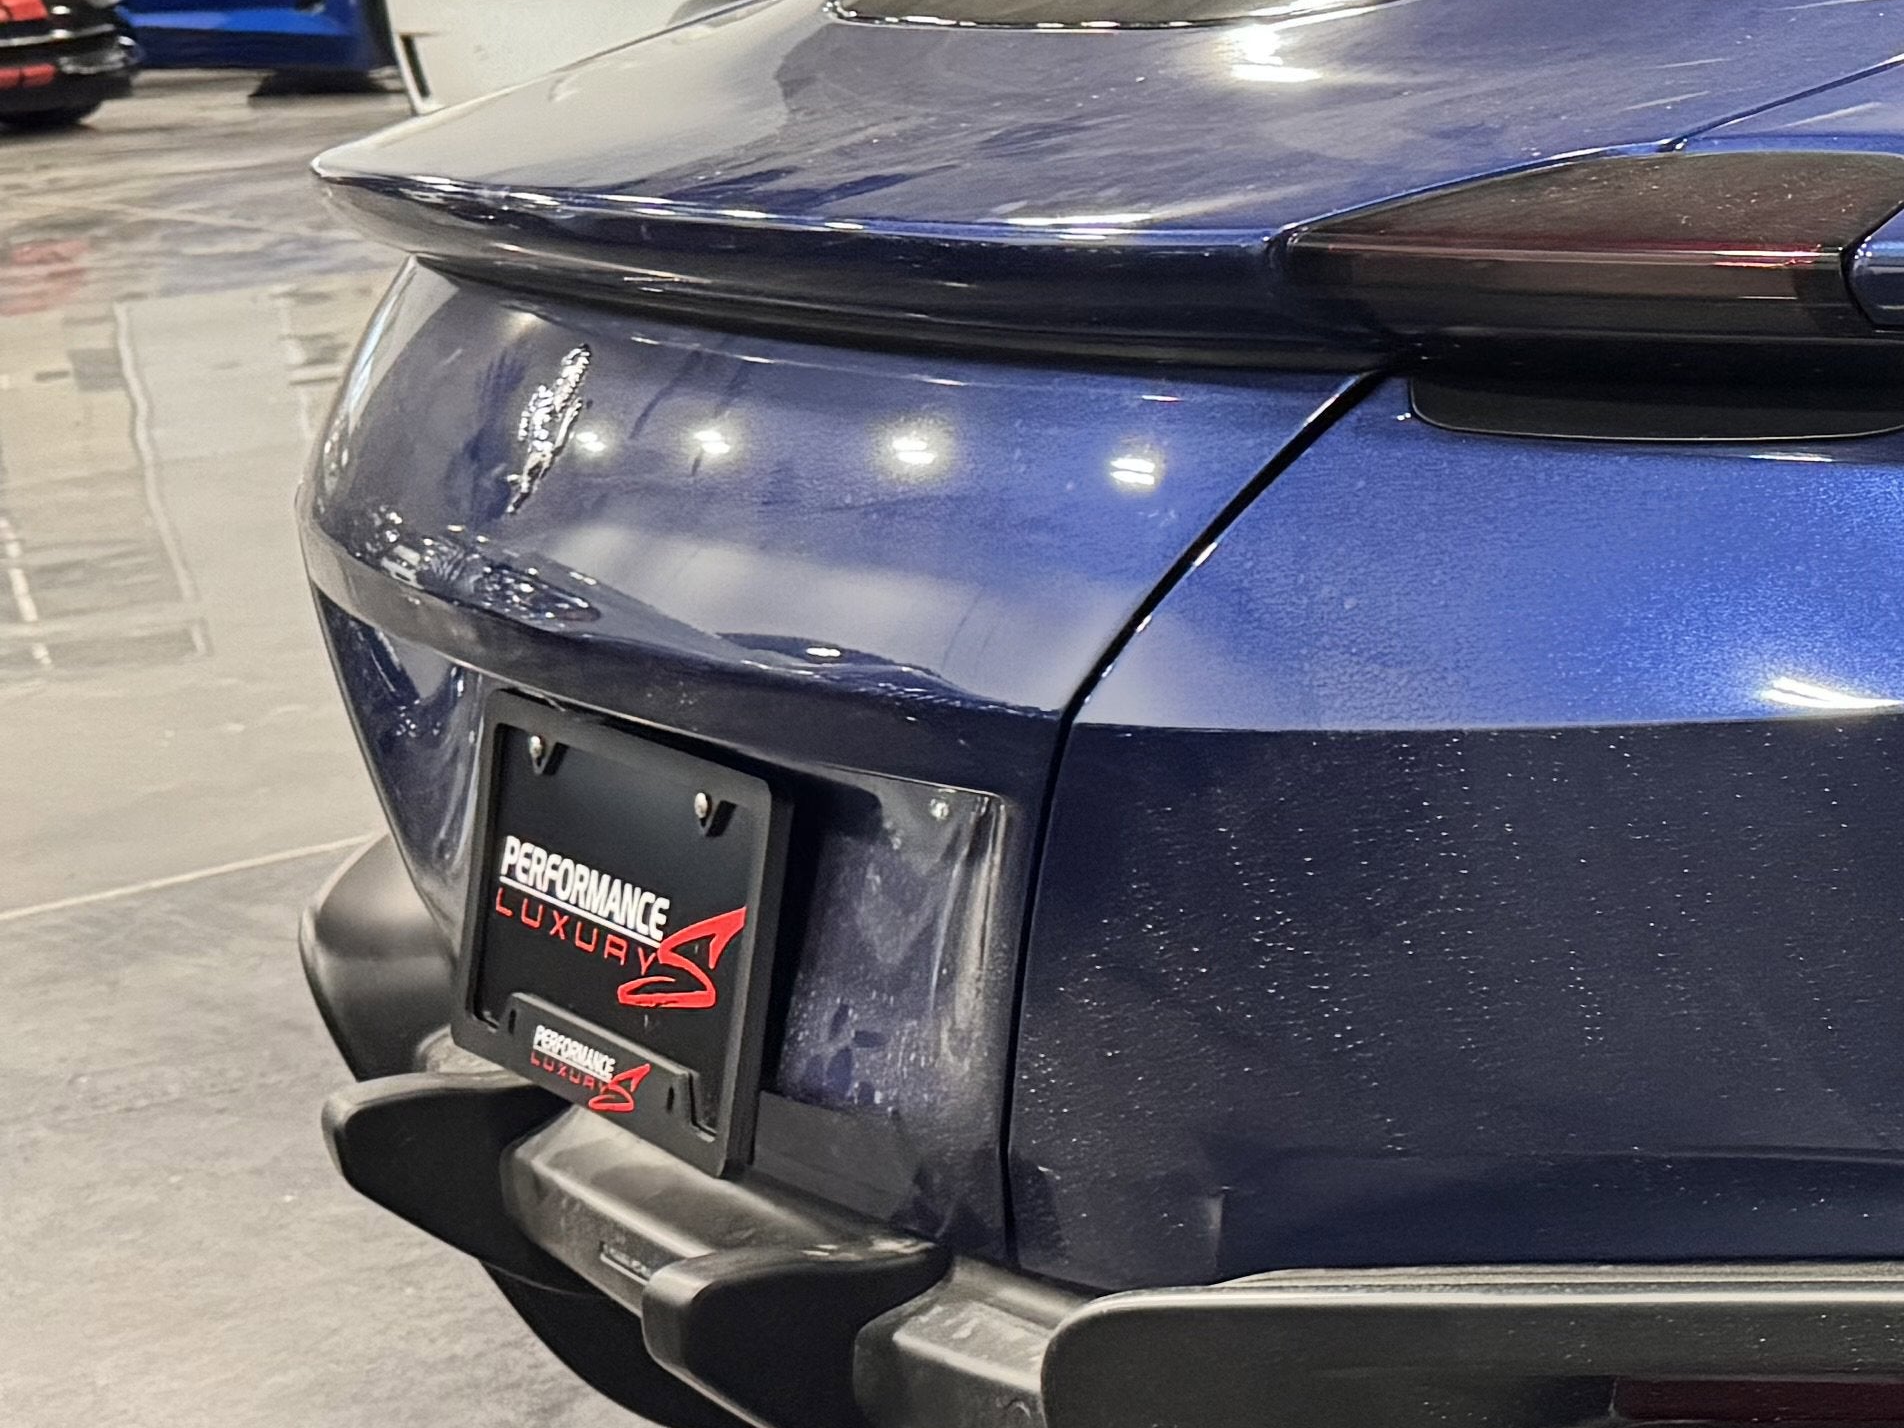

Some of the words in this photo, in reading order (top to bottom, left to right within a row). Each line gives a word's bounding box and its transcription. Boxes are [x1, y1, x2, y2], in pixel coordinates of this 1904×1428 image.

[495, 886, 656, 976] LUXURY
[502, 835, 670, 941] PERFORMANCE
[533, 1024, 616, 1082] PERFORMANCE
